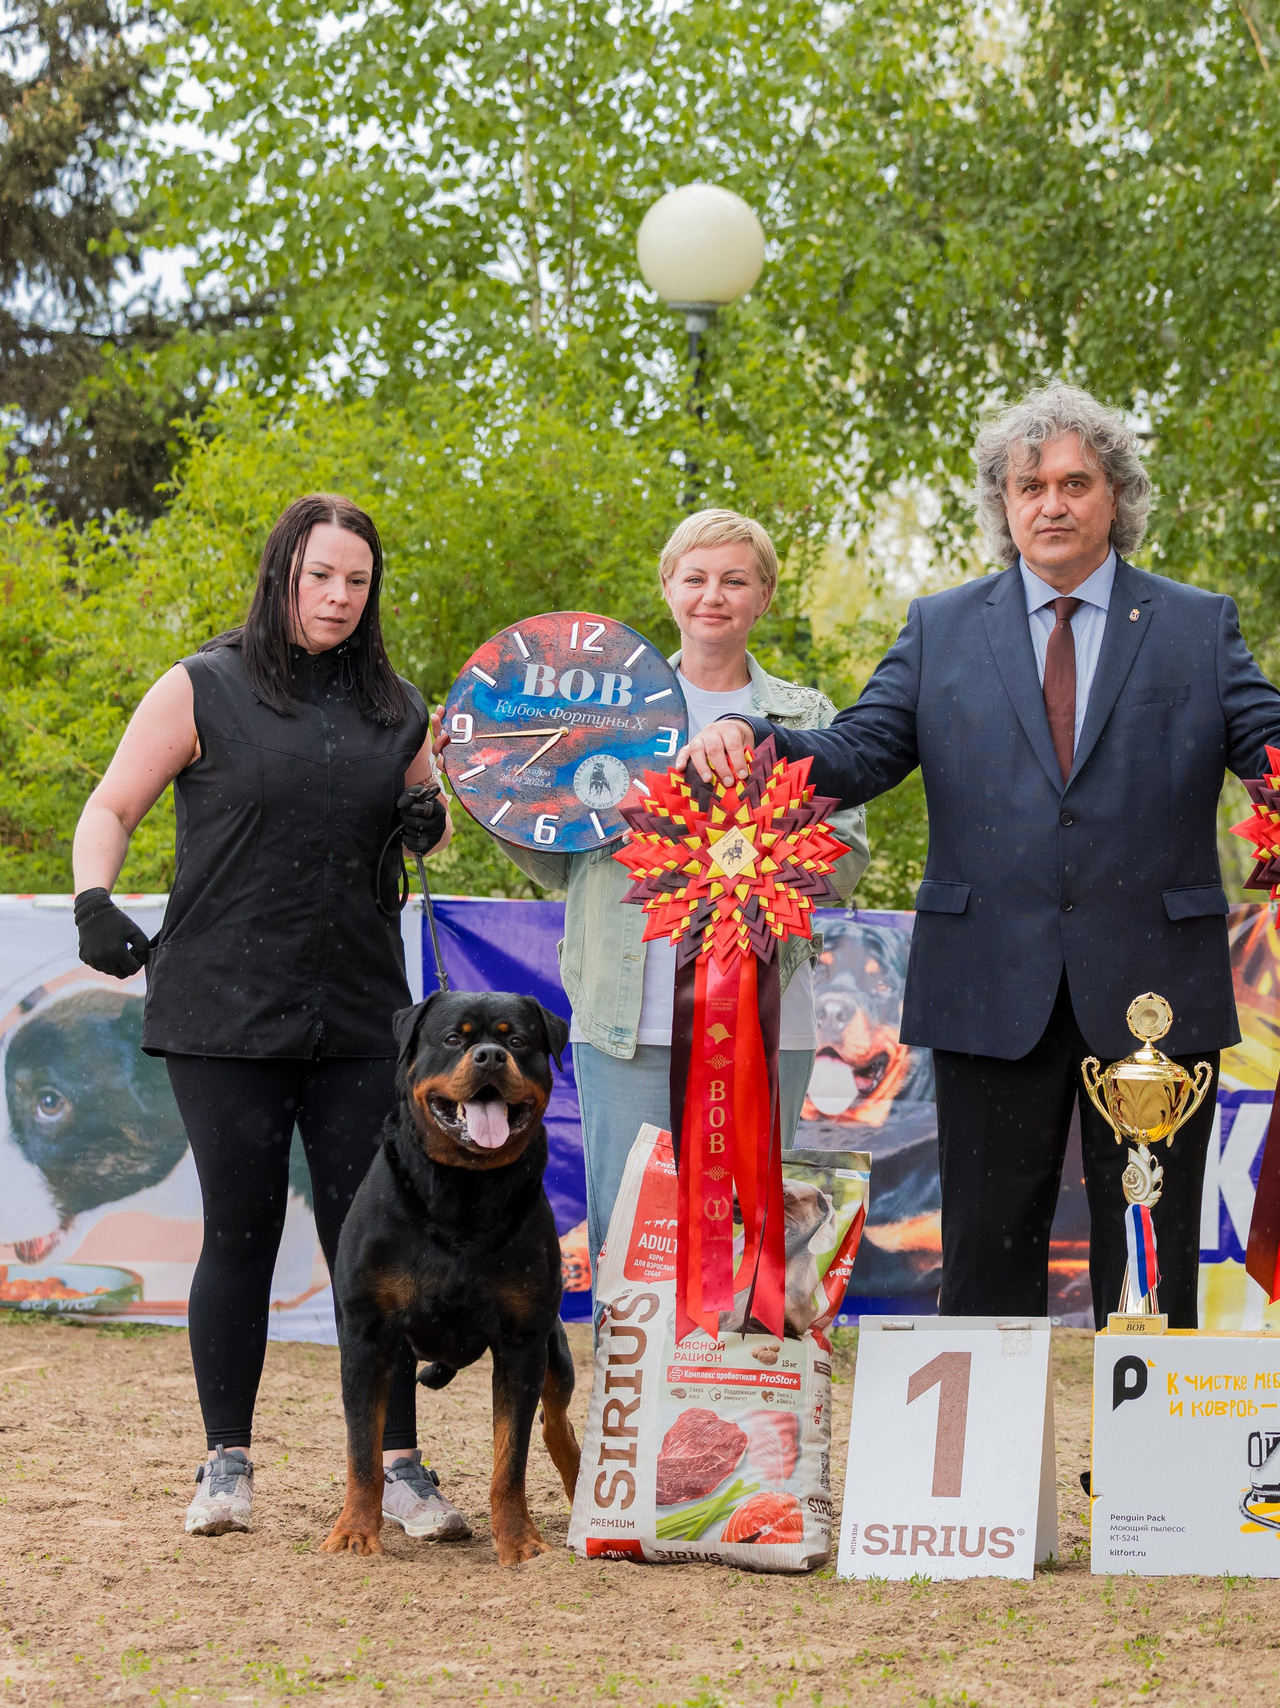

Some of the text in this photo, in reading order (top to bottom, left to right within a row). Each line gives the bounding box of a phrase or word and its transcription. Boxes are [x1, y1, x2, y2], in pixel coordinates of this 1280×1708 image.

[570, 620, 607, 653] 12
[518, 662, 633, 707] BOB
[495, 699, 548, 718] Кубок
[549, 706, 630, 729] Фортуны
[451, 713, 473, 744] 9
[653, 726, 679, 757] 3
[534, 814, 559, 844] 6
[708, 1080, 726, 1154] BOB
[649, 1253, 664, 1262] КОРМ
[634, 1259, 675, 1271] ДЛЯ ВЗРОСЛЫХ
[644, 1269, 661, 1277] СОБАК
[1126, 1323, 1146, 1332] BOB
[675, 1340, 726, 1351] МЯСНОЙ
[674, 1352, 722, 1363] РАЦИОН
[781, 1360, 790, 1368] 15
[684, 1370, 798, 1385] Комплекс пробиотиков ProStor+
[1166, 1372, 1179, 1395] К
[594, 1292, 660, 1510] SIRIUS
[907, 1352, 972, 1498] 1
[590, 1517, 635, 1529] PREMIUM
[1110, 1514, 1166, 1523] Penguin Pack
[1110, 1525, 1186, 1533] Моющий пылесос
[850, 1523, 859, 1555] PREMIUM
[862, 1523, 1015, 1559] SIRIUS
[1109, 1534, 1140, 1542] KT-5241
[654, 1549, 723, 1563] SIRIUS
[1109, 1548, 1147, 1557] kitfort.ru
